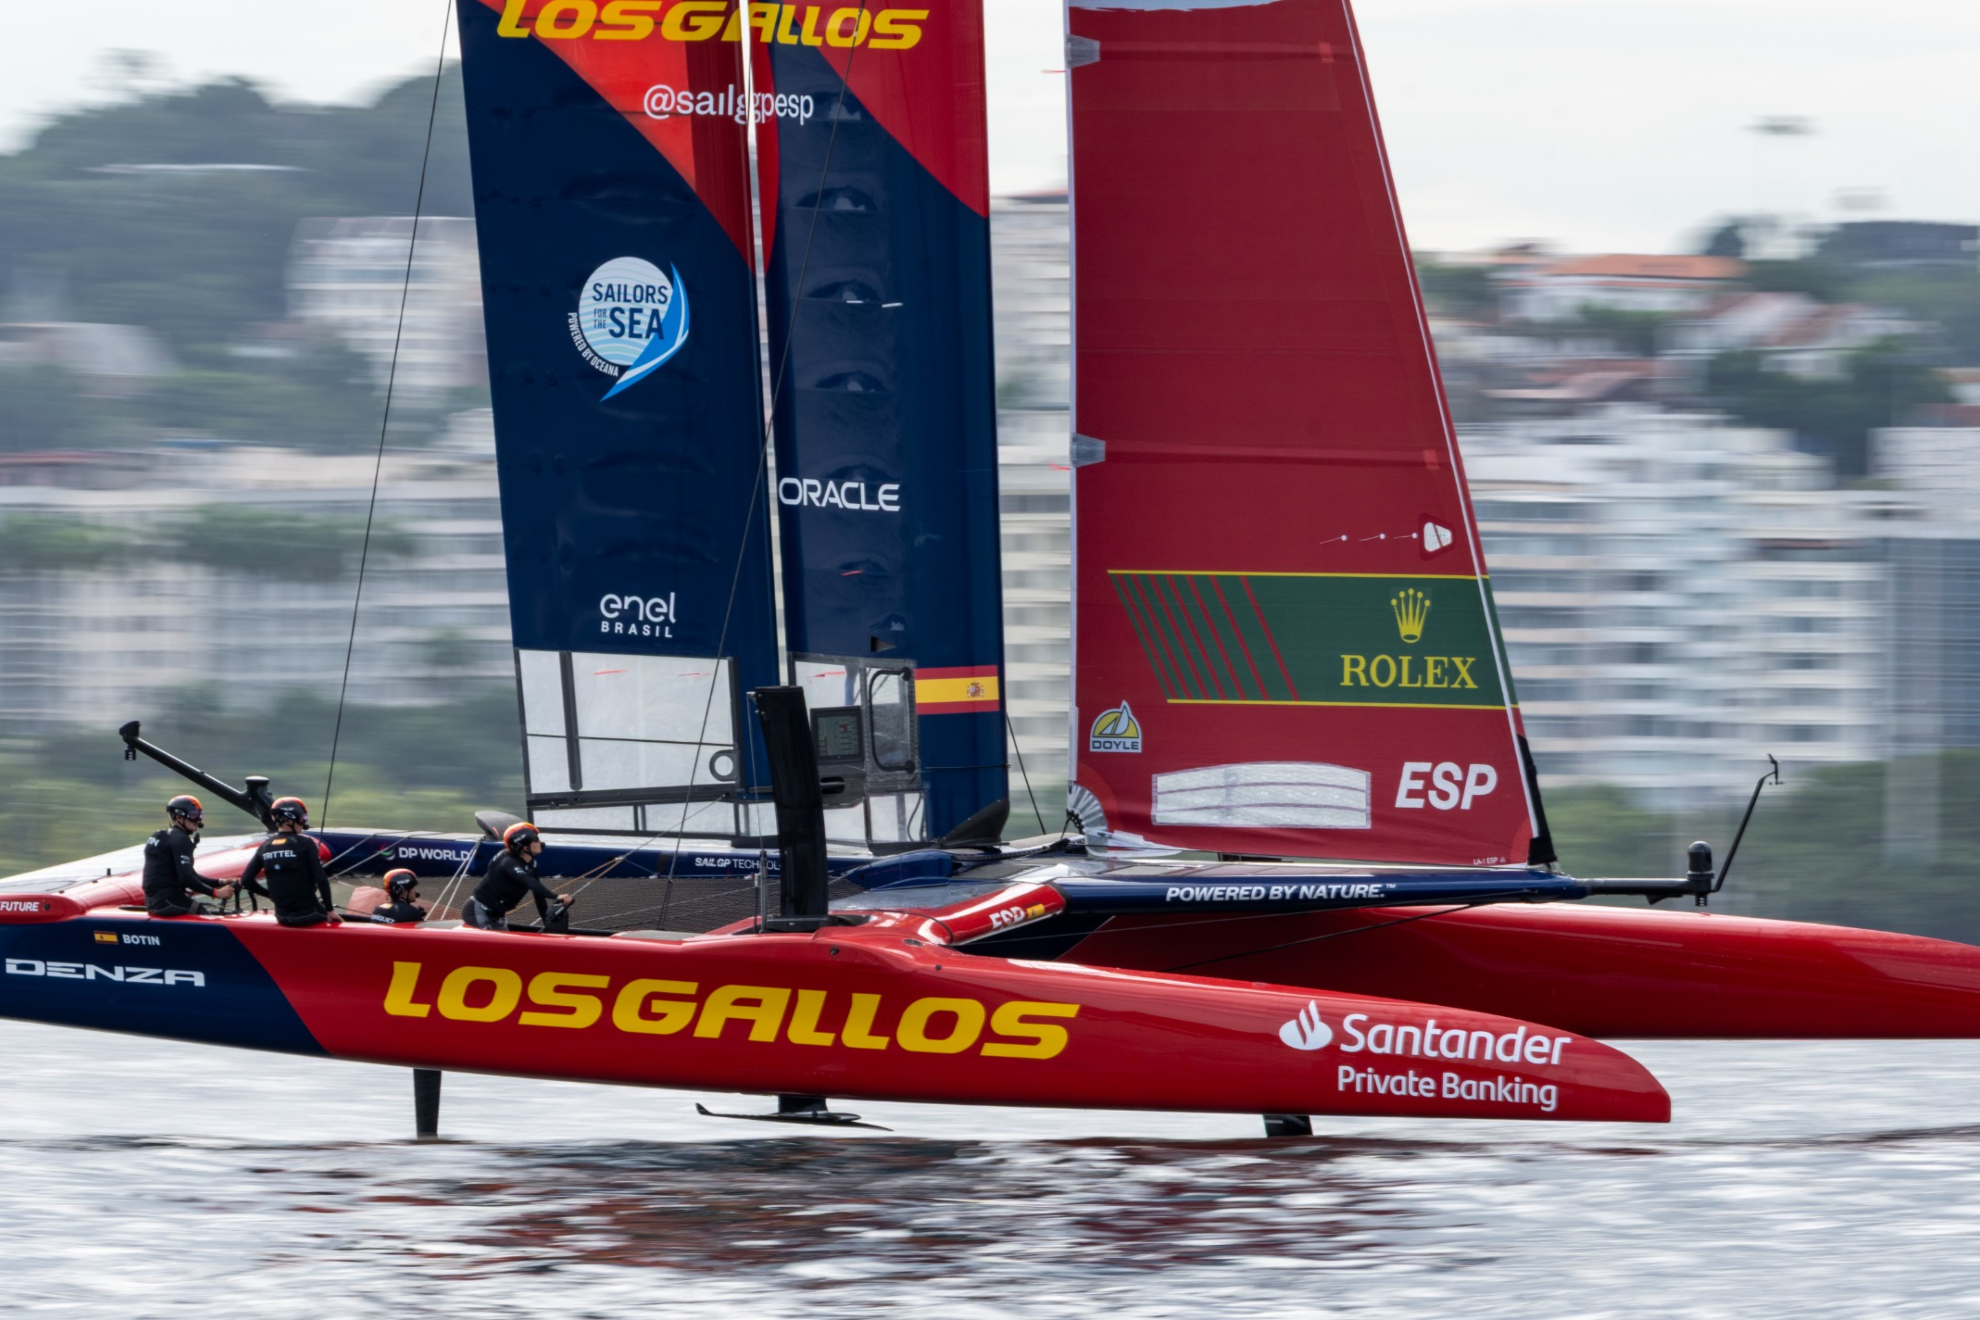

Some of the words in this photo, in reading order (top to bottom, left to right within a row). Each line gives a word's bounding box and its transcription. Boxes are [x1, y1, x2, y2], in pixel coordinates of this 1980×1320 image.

[497, 0, 929, 49] LOSGALLOS
[592, 282, 669, 304] SAILORS
[593, 308, 607, 318] FOR
[593, 319, 607, 329] THE
[608, 306, 665, 340] SEA
[567, 312, 586, 352] POWERED
[581, 348, 594, 361] BY
[590, 356, 619, 377] OCEANA
[778, 477, 901, 512] ORACLE
[600, 592, 676, 624] enel
[601, 620, 673, 638] BRASIL
[1340, 654, 1478, 689] ROLEX
[1091, 740, 1140, 751] DOYLE
[1395, 761, 1498, 811] ESP
[262, 850, 297, 860] TRITTEL
[398, 847, 418, 860] DP
[422, 849, 471, 862] WORLD
[1166, 886, 1265, 901] POWERED
[1268, 885, 1297, 899] BY
[5, 958, 206, 987] DENZA
[383, 961, 1080, 1060] LOSGALLOS
[1340, 1013, 1572, 1065] Santander
[1337, 1065, 1436, 1098] Private
[1442, 1072, 1557, 1112] Banking
